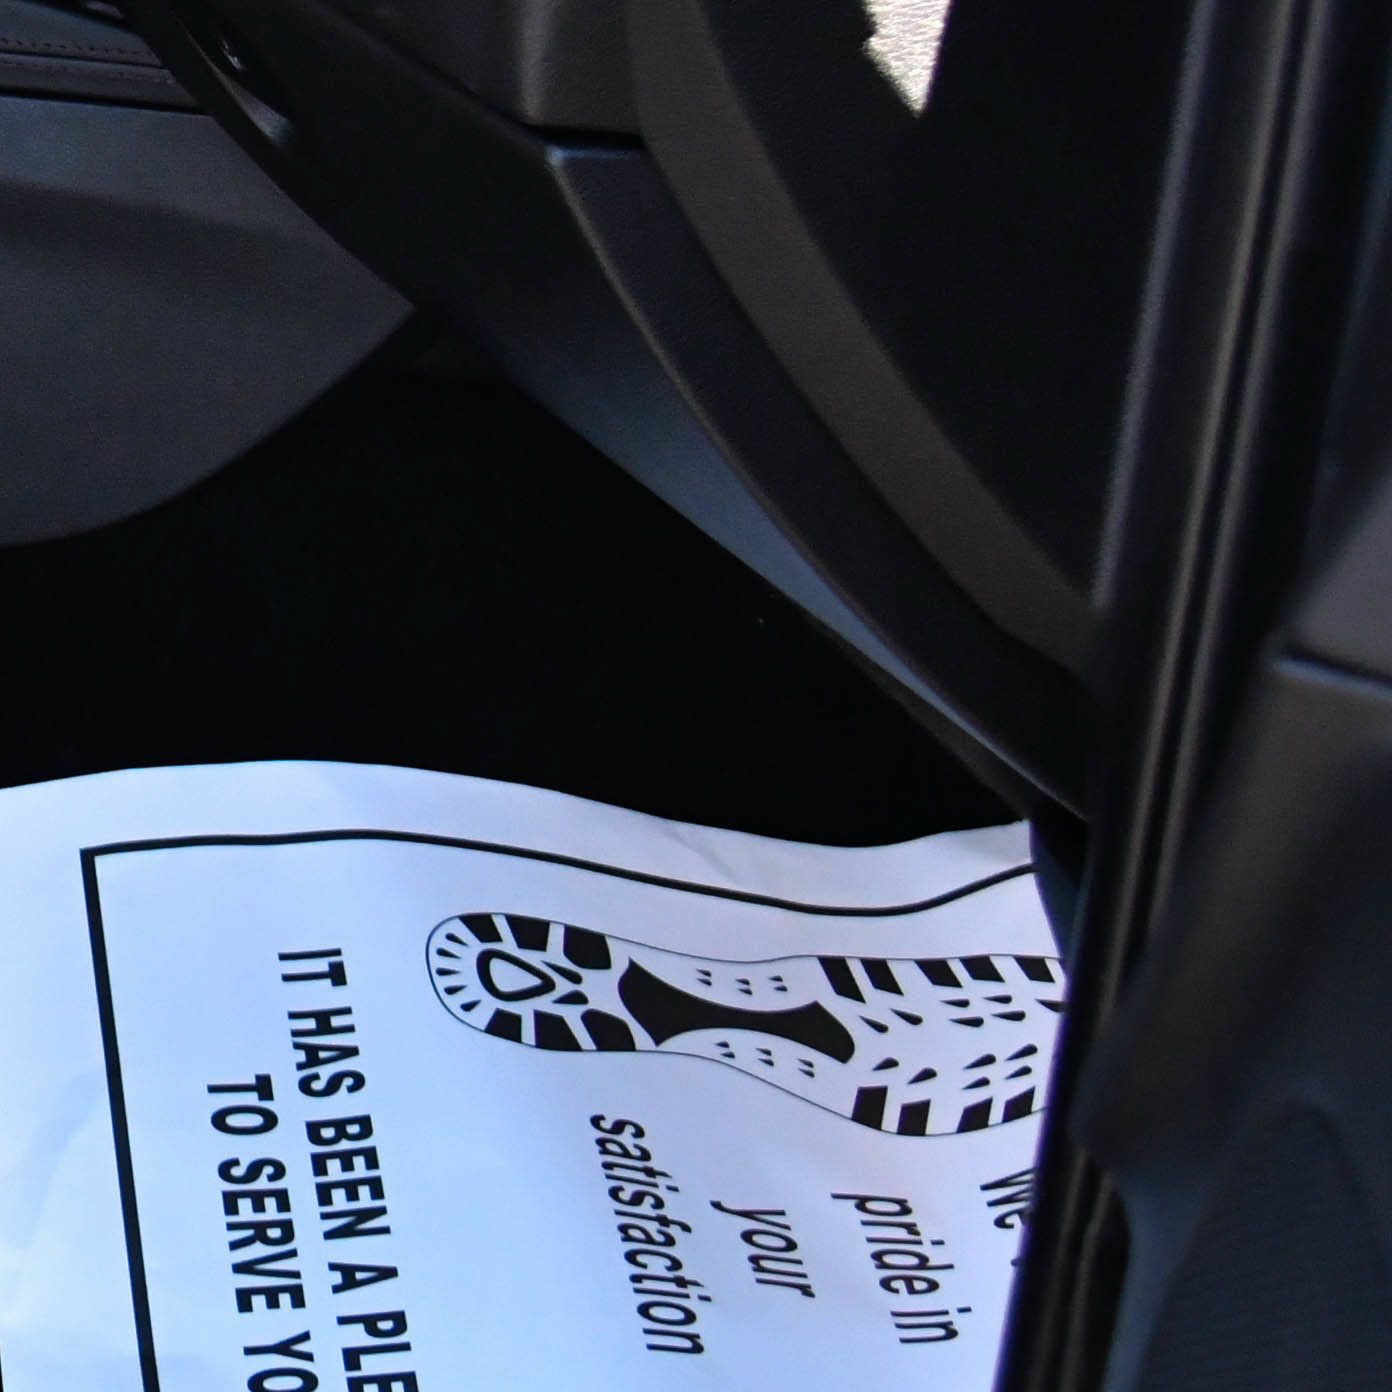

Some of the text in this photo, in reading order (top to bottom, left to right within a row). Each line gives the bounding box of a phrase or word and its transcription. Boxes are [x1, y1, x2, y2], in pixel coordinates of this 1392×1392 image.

[278, 948, 347, 987] IT
[287, 1006, 366, 1097] HAS
[207, 1073, 279, 1136] TO
[305, 1114, 392, 1240] BEEN
[217, 1157, 306, 1313] SERVE
[328, 1261, 398, 1294] A
[589, 1113, 712, 1354] satisfaction
[709, 1200, 816, 1298] your
[831, 1193, 972, 1344] pride in
